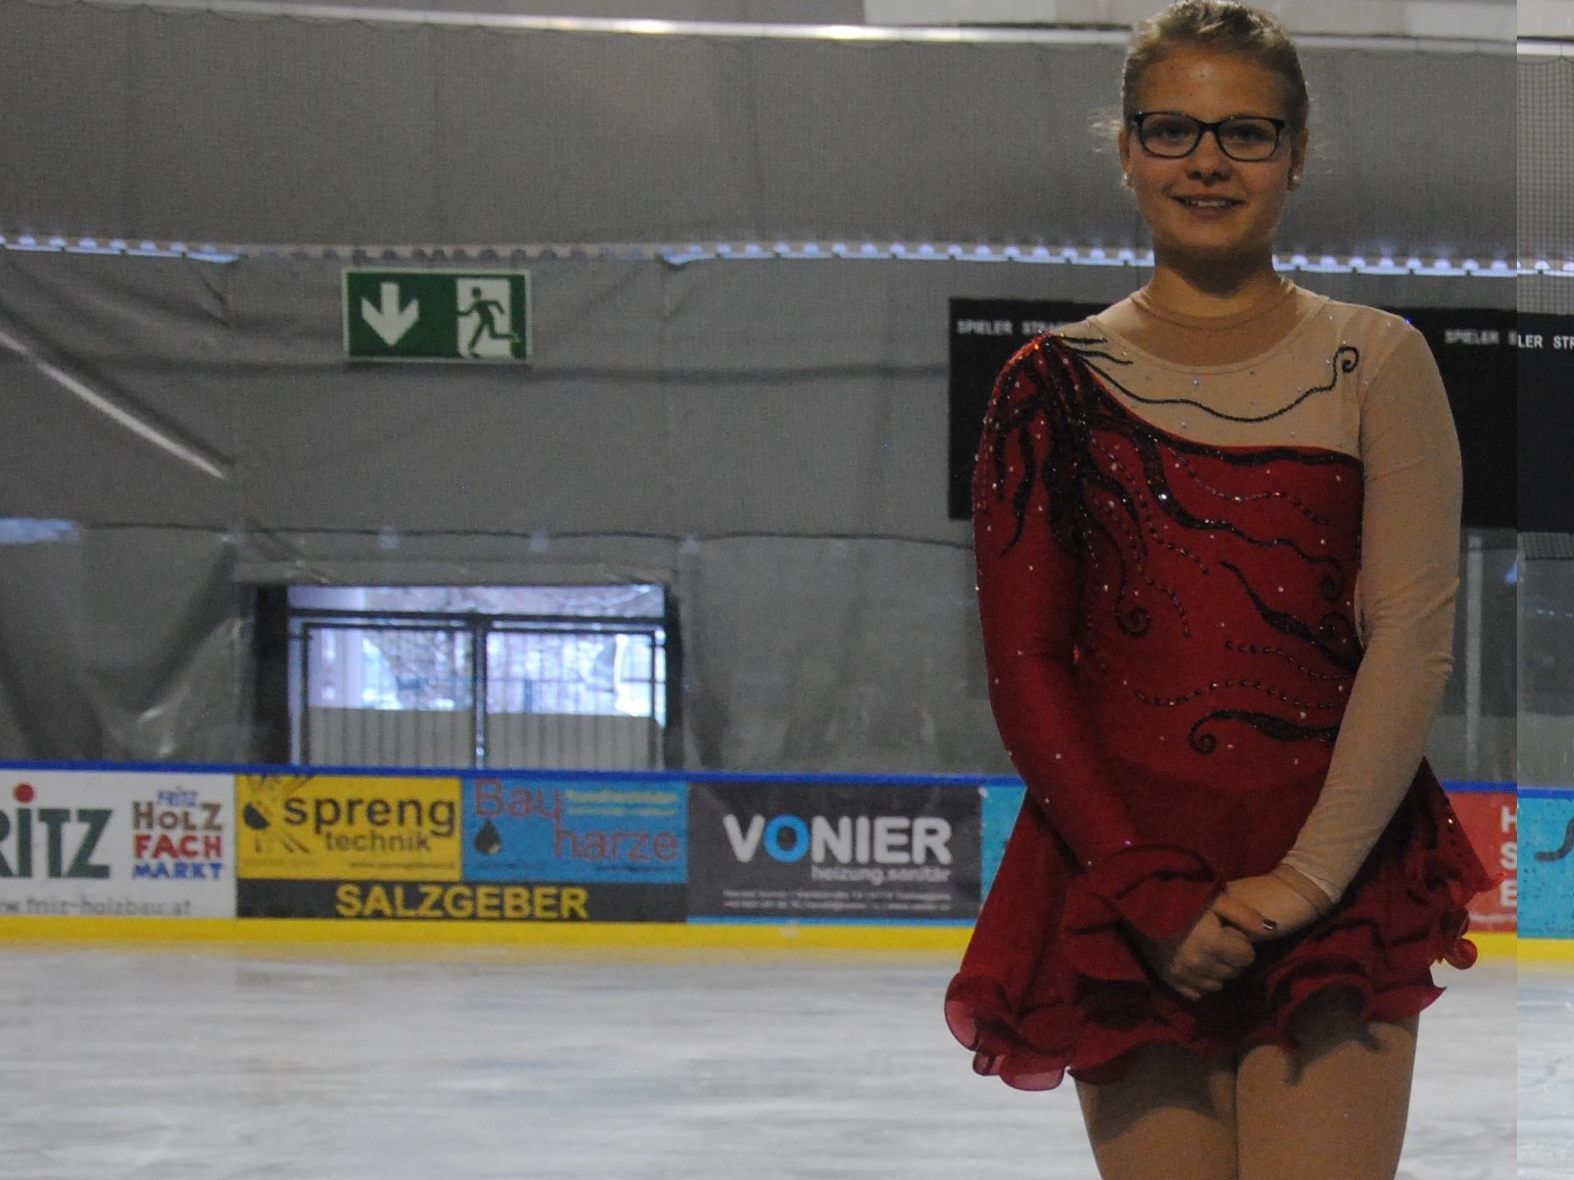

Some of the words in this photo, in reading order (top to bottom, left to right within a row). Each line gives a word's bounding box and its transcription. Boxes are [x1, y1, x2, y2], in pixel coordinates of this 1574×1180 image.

[132, 801, 224, 831] HOLZ
[284, 796, 456, 838] spreng
[133, 833, 224, 859] FACH
[325, 829, 431, 851] technik
[722, 813, 953, 865] VONIER
[132, 862, 223, 880] MARKT
[336, 883, 590, 920] SALZGEBER
